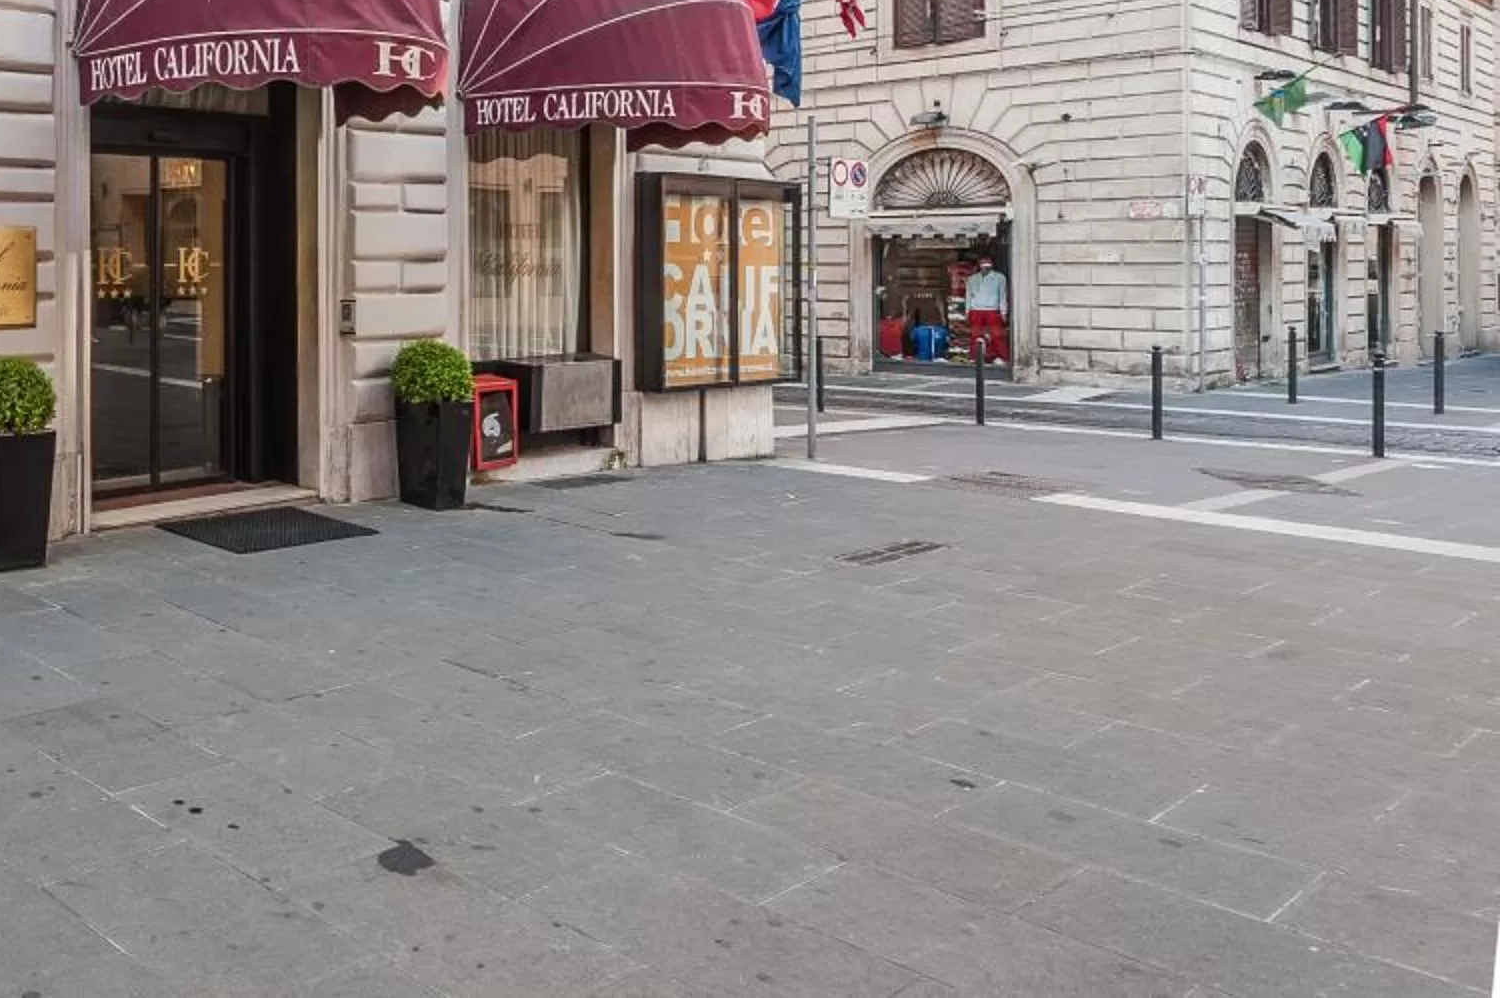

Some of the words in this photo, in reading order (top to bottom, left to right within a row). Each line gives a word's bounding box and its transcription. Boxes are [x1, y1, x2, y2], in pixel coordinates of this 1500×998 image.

[90, 52, 147, 91] HOTEL
[154, 37, 300, 82] CALIFORNIA
[476, 97, 536, 126] HOTEL
[543, 89, 676, 121] CALIFORNIA
